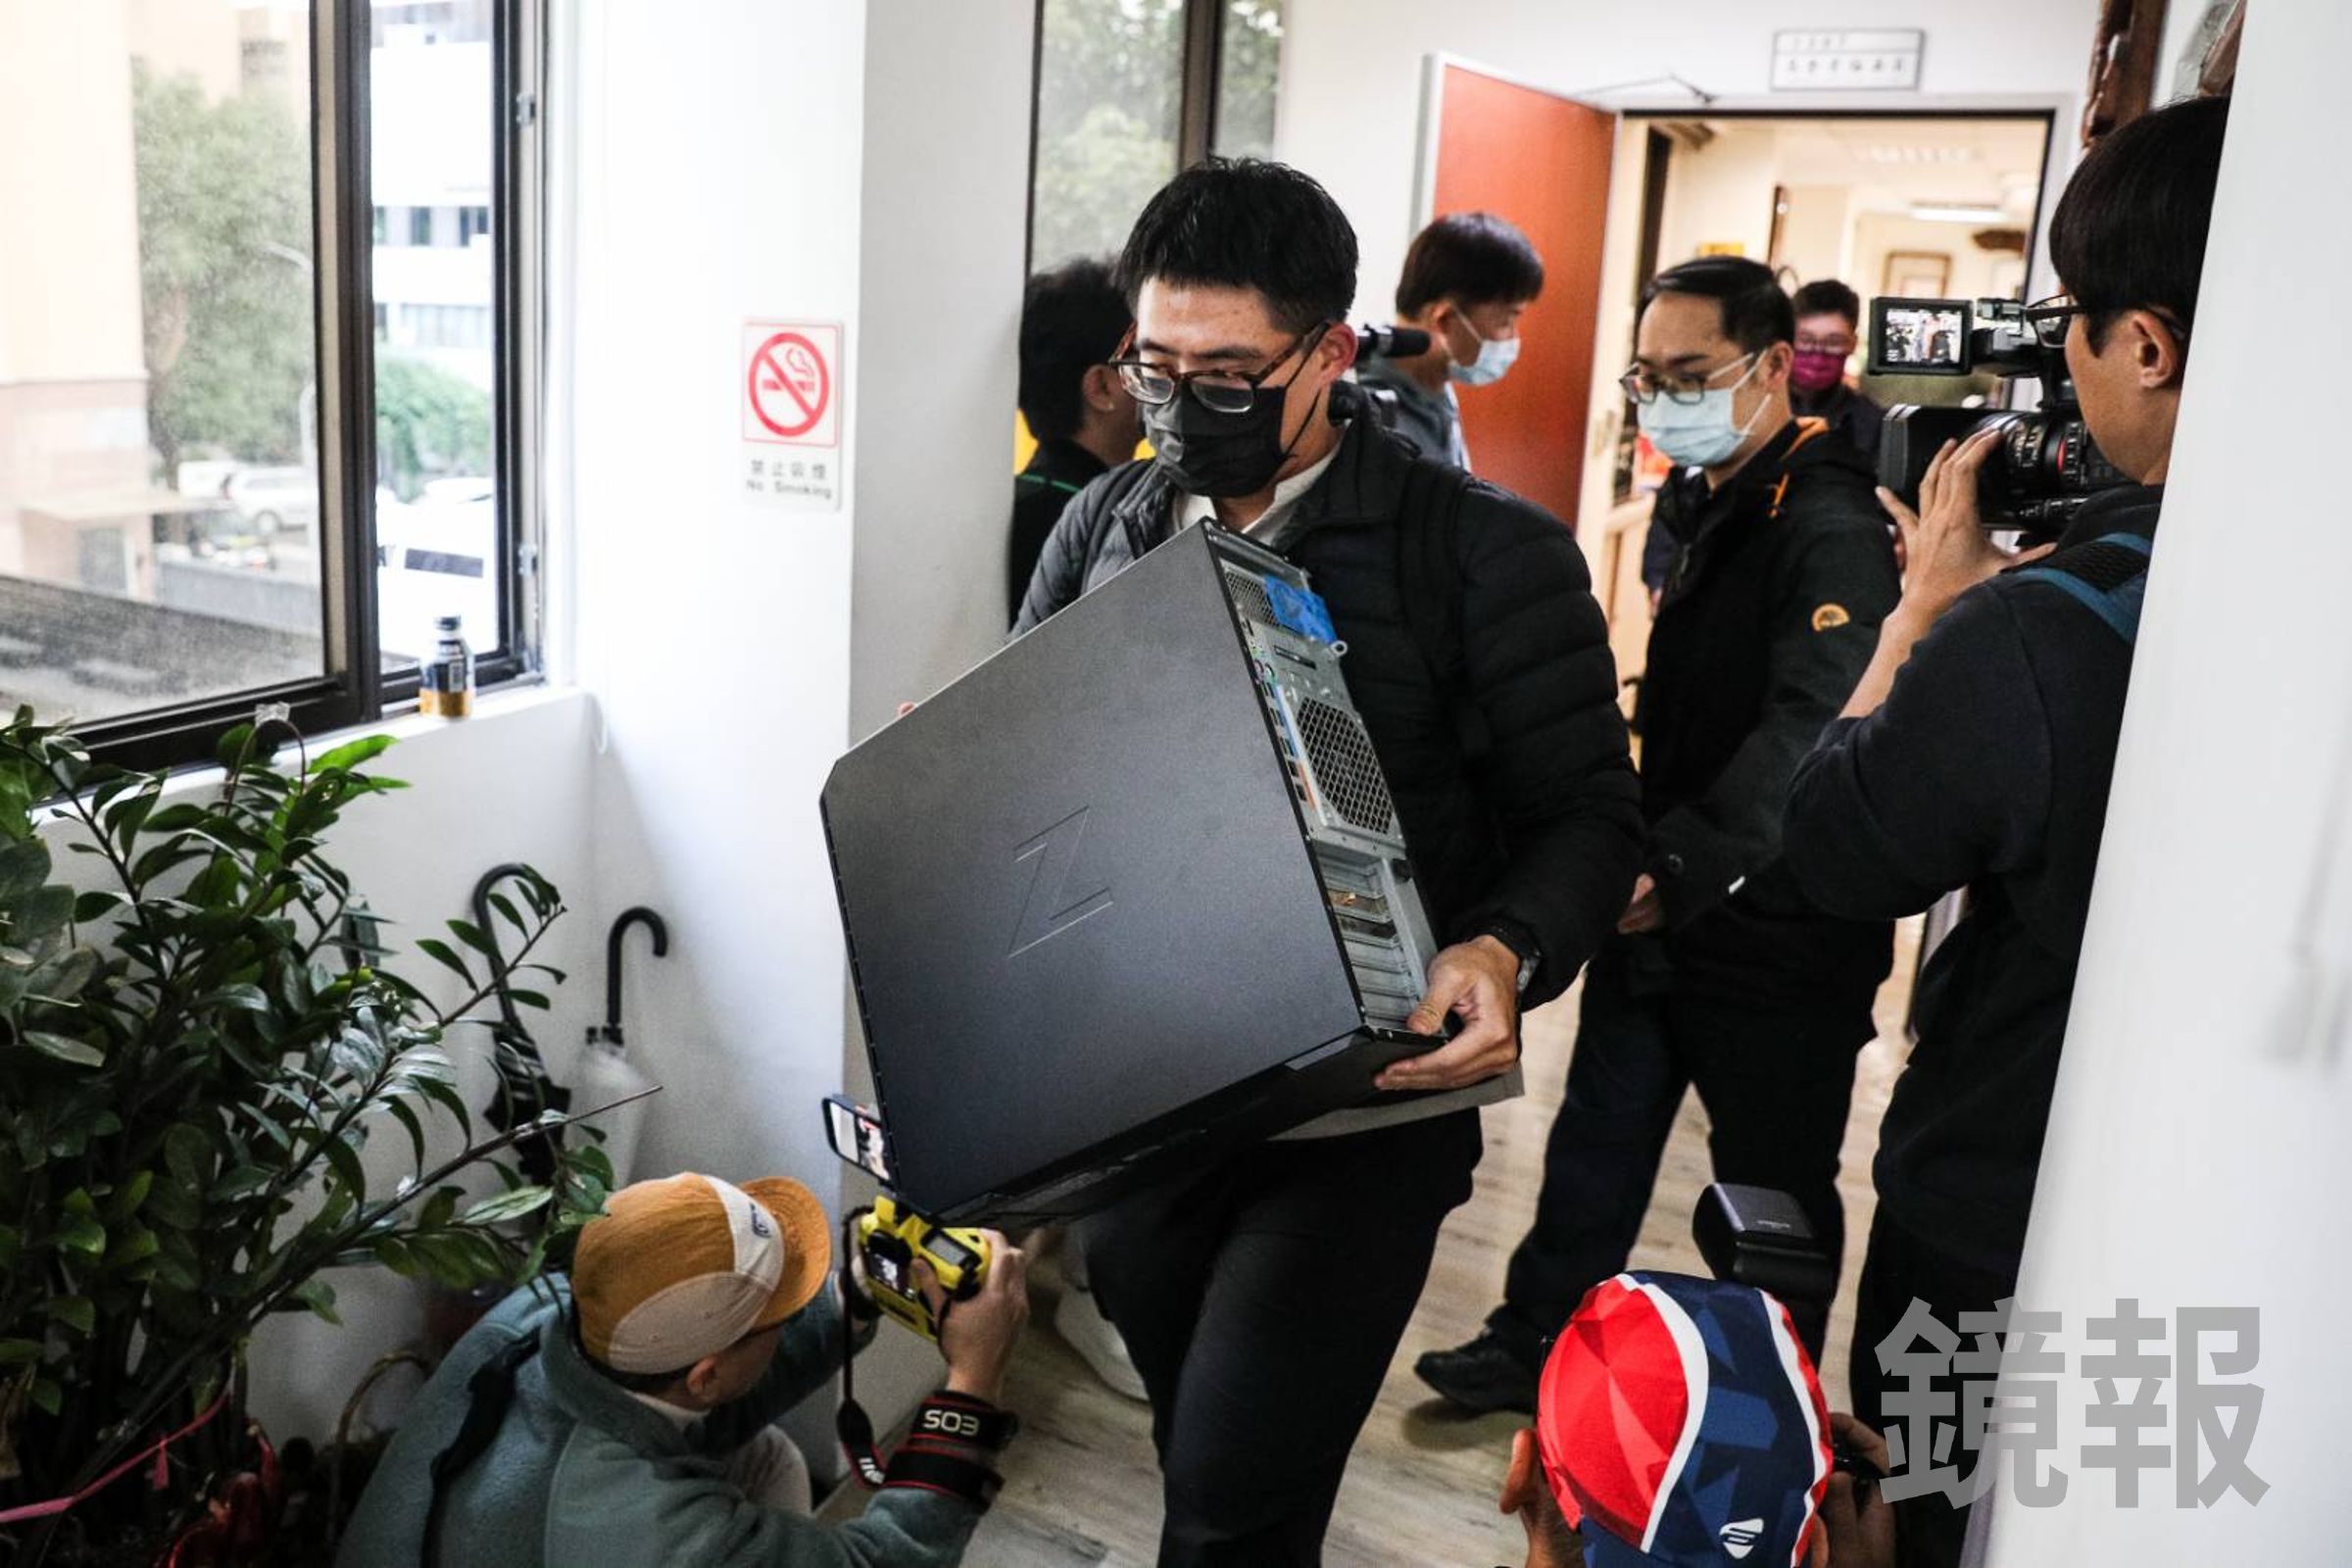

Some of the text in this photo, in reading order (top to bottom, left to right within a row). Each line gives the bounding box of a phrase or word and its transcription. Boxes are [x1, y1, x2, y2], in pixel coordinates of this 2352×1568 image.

[746, 480, 832, 500] No Smoking
[923, 1409, 980, 1436] EOS
